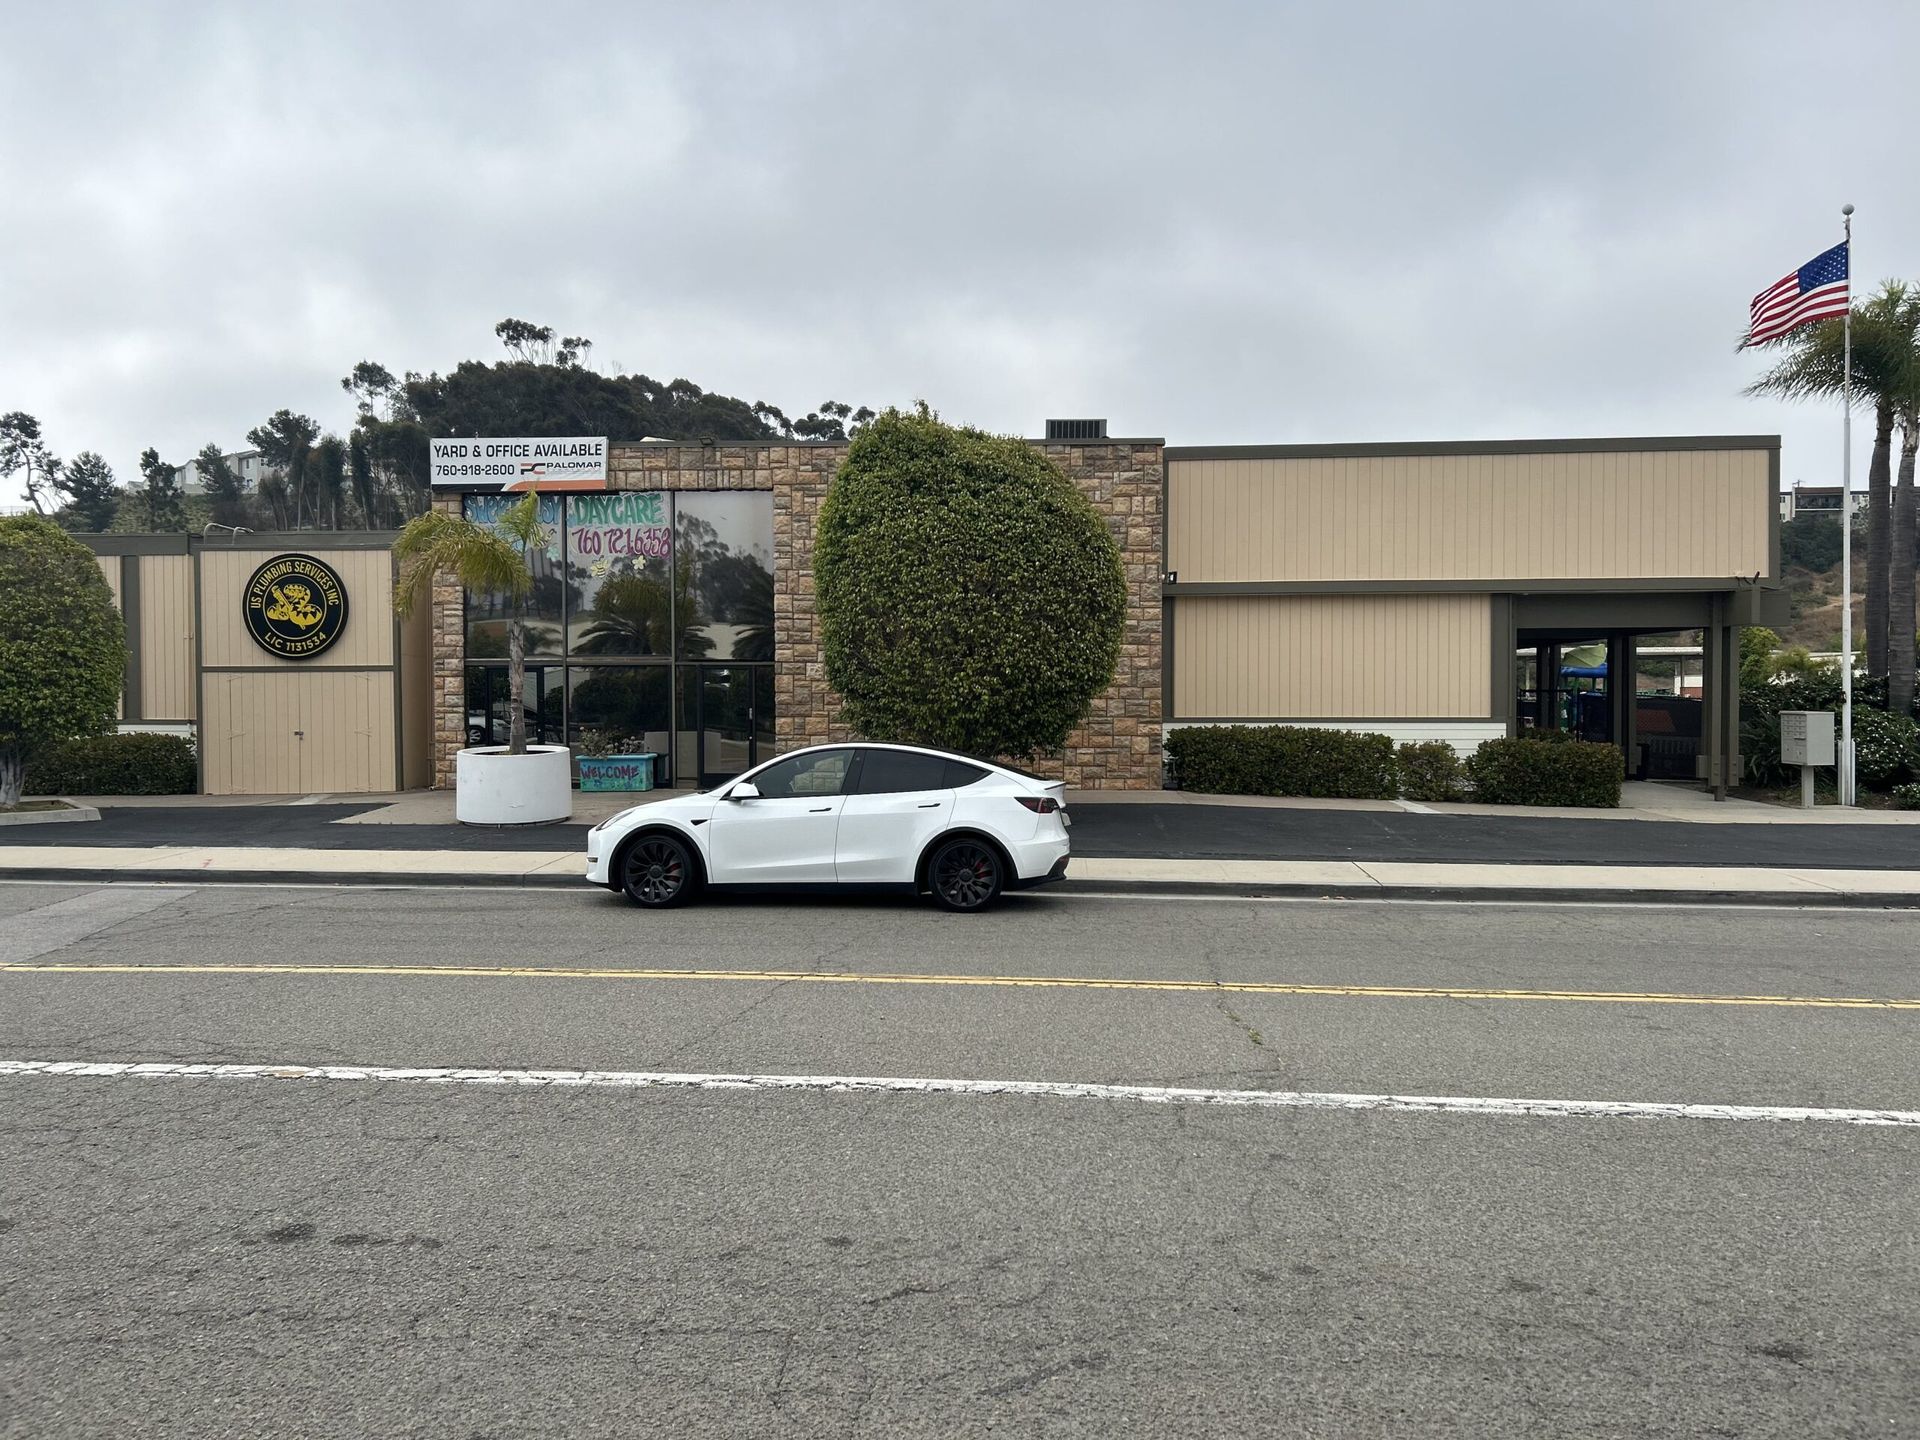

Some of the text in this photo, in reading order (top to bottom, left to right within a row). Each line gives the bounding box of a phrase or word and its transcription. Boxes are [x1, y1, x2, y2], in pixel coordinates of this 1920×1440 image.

[434, 443, 603, 458] YARD & OFFICE AVAILABLE
[436, 464, 515, 476] 760-918-2600
[546, 461, 602, 469] PALOMAR
[573, 493, 665, 525] DAYCARE
[250, 561, 339, 609] US PLUMBING SERVICES INC
[264, 631, 327, 651] LIC 1131534
[579, 764, 639, 779] WELCOME
